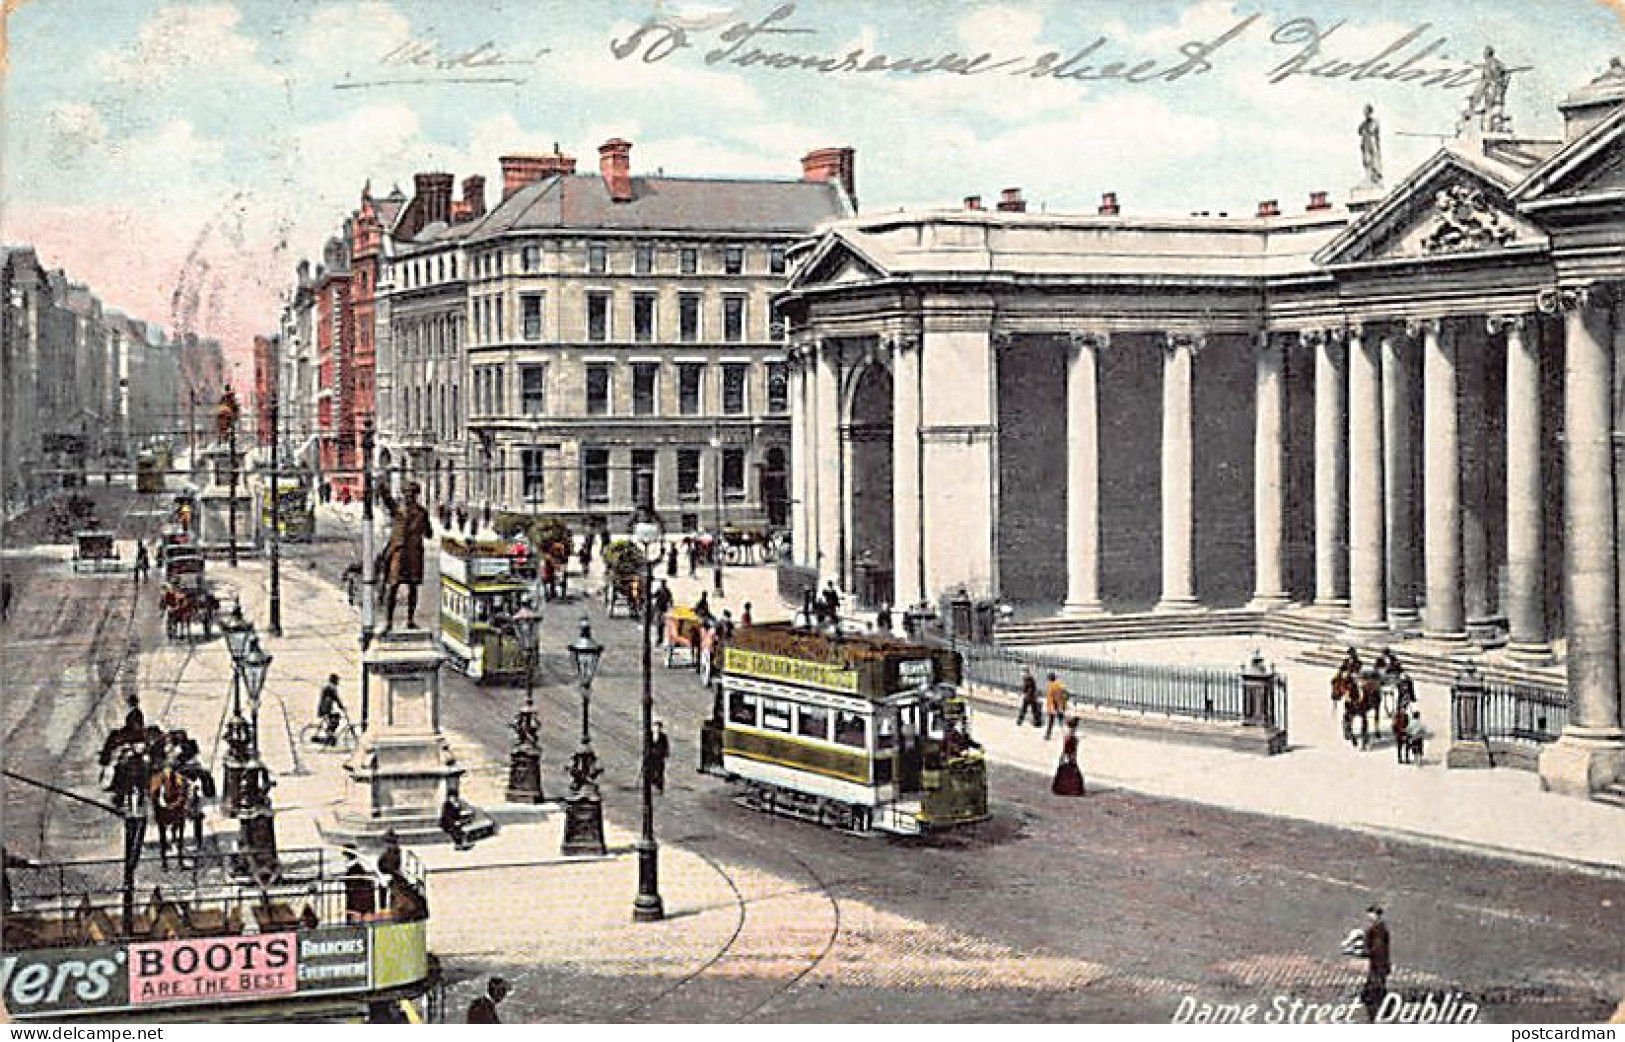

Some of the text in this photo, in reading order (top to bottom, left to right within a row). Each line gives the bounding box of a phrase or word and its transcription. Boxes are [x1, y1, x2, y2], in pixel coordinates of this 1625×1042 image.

[137, 938, 289, 977] BOOTS
[141, 972, 285, 997] ARE THE BEST
